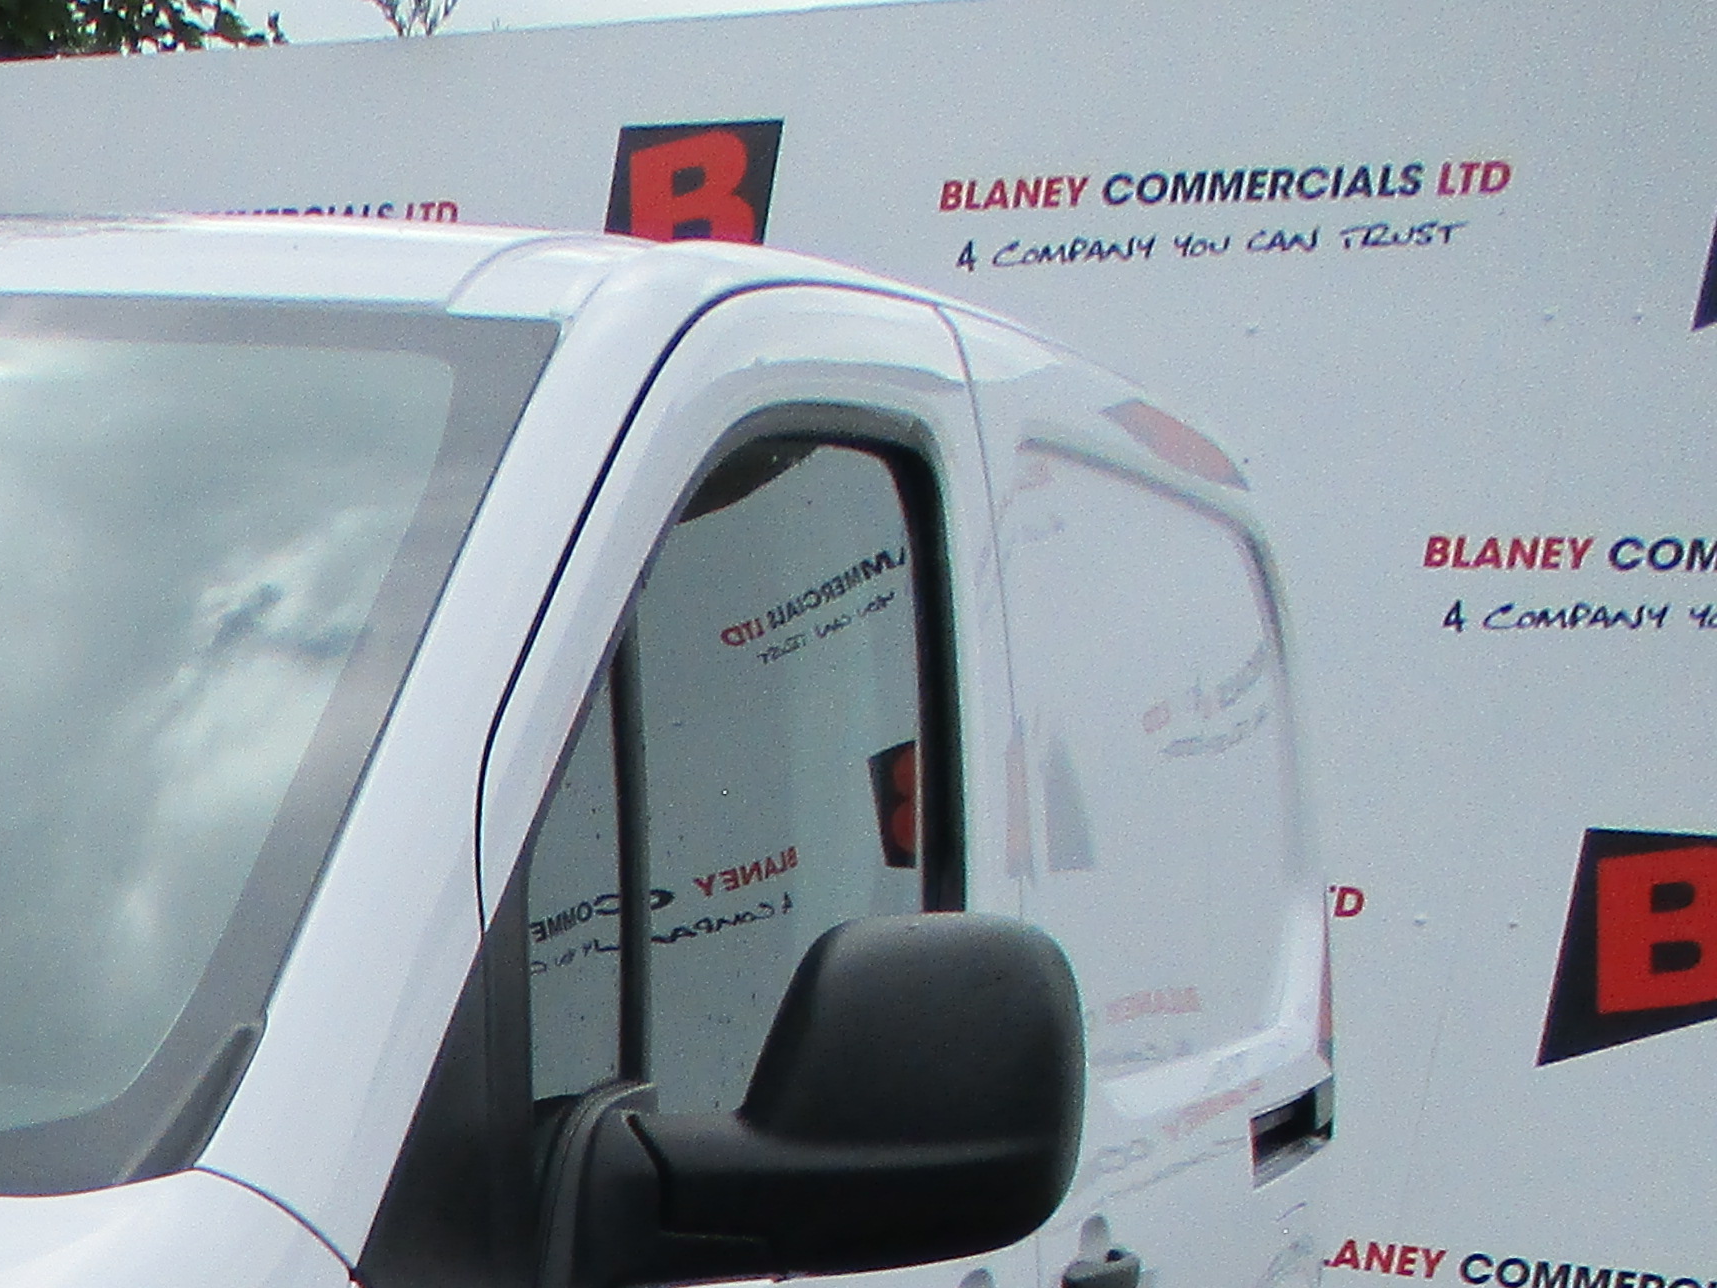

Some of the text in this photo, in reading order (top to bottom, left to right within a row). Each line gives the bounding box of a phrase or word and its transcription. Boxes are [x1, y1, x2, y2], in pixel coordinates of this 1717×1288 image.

[939, 160, 1513, 212] BLANEY COMMERCIALS LTD
[992, 234, 1157, 268] COMPANY
[1173, 232, 1230, 258] YOU
[1246, 226, 1320, 253] CAN
[1340, 220, 1469, 250] TRUST
[1423, 535, 1595, 571] BLANEY
[1482, 601, 1671, 631] COMPANY
[1324, 1238, 1447, 1280] ANEY
